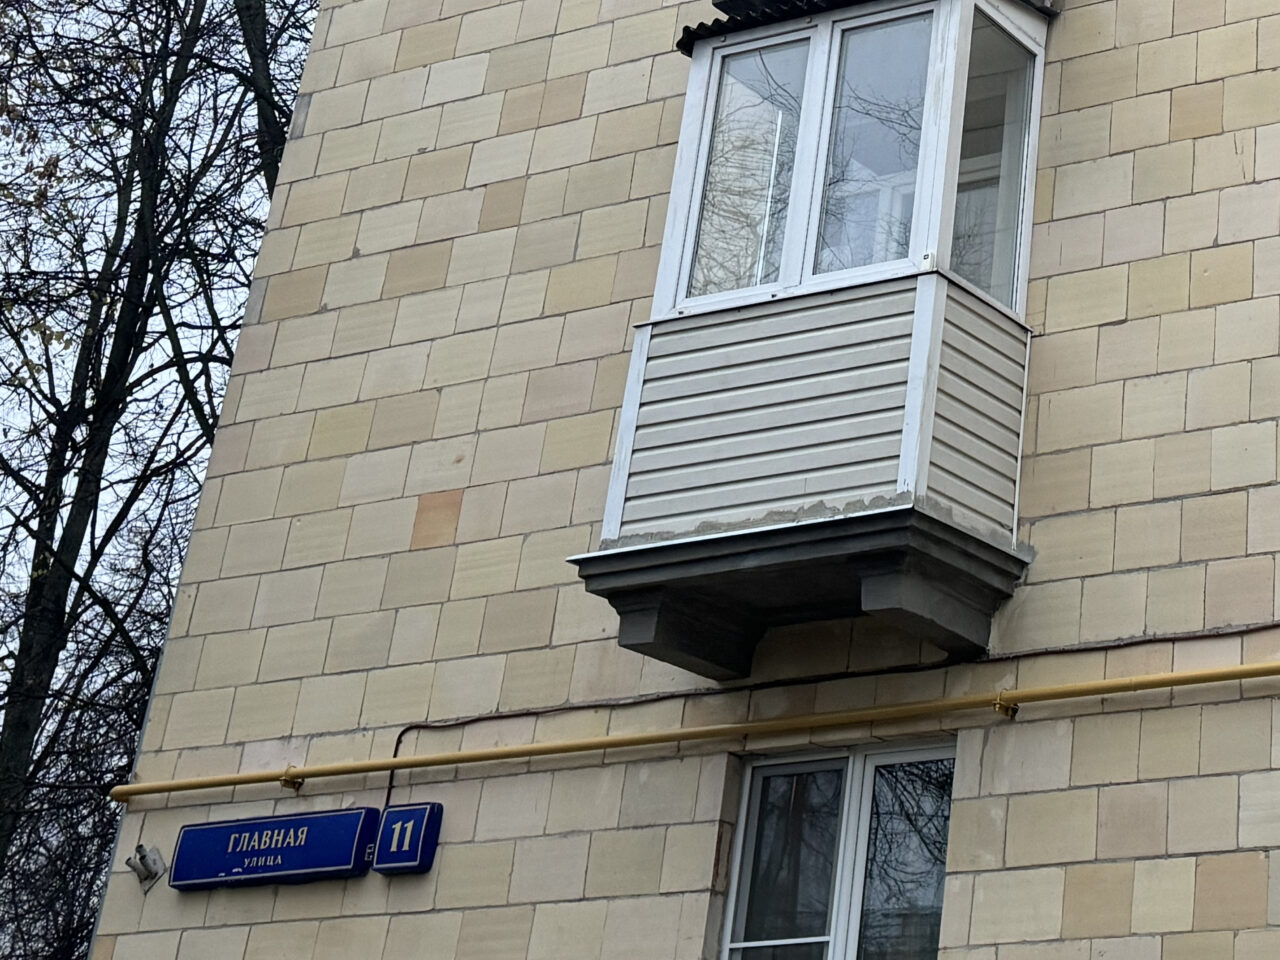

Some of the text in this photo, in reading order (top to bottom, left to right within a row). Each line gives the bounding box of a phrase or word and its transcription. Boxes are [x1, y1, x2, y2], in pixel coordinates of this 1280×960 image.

[227, 826, 309, 852] ГЛАВНАЯ
[390, 819, 415, 852] 11
[243, 854, 282, 868] УЛИЦА
